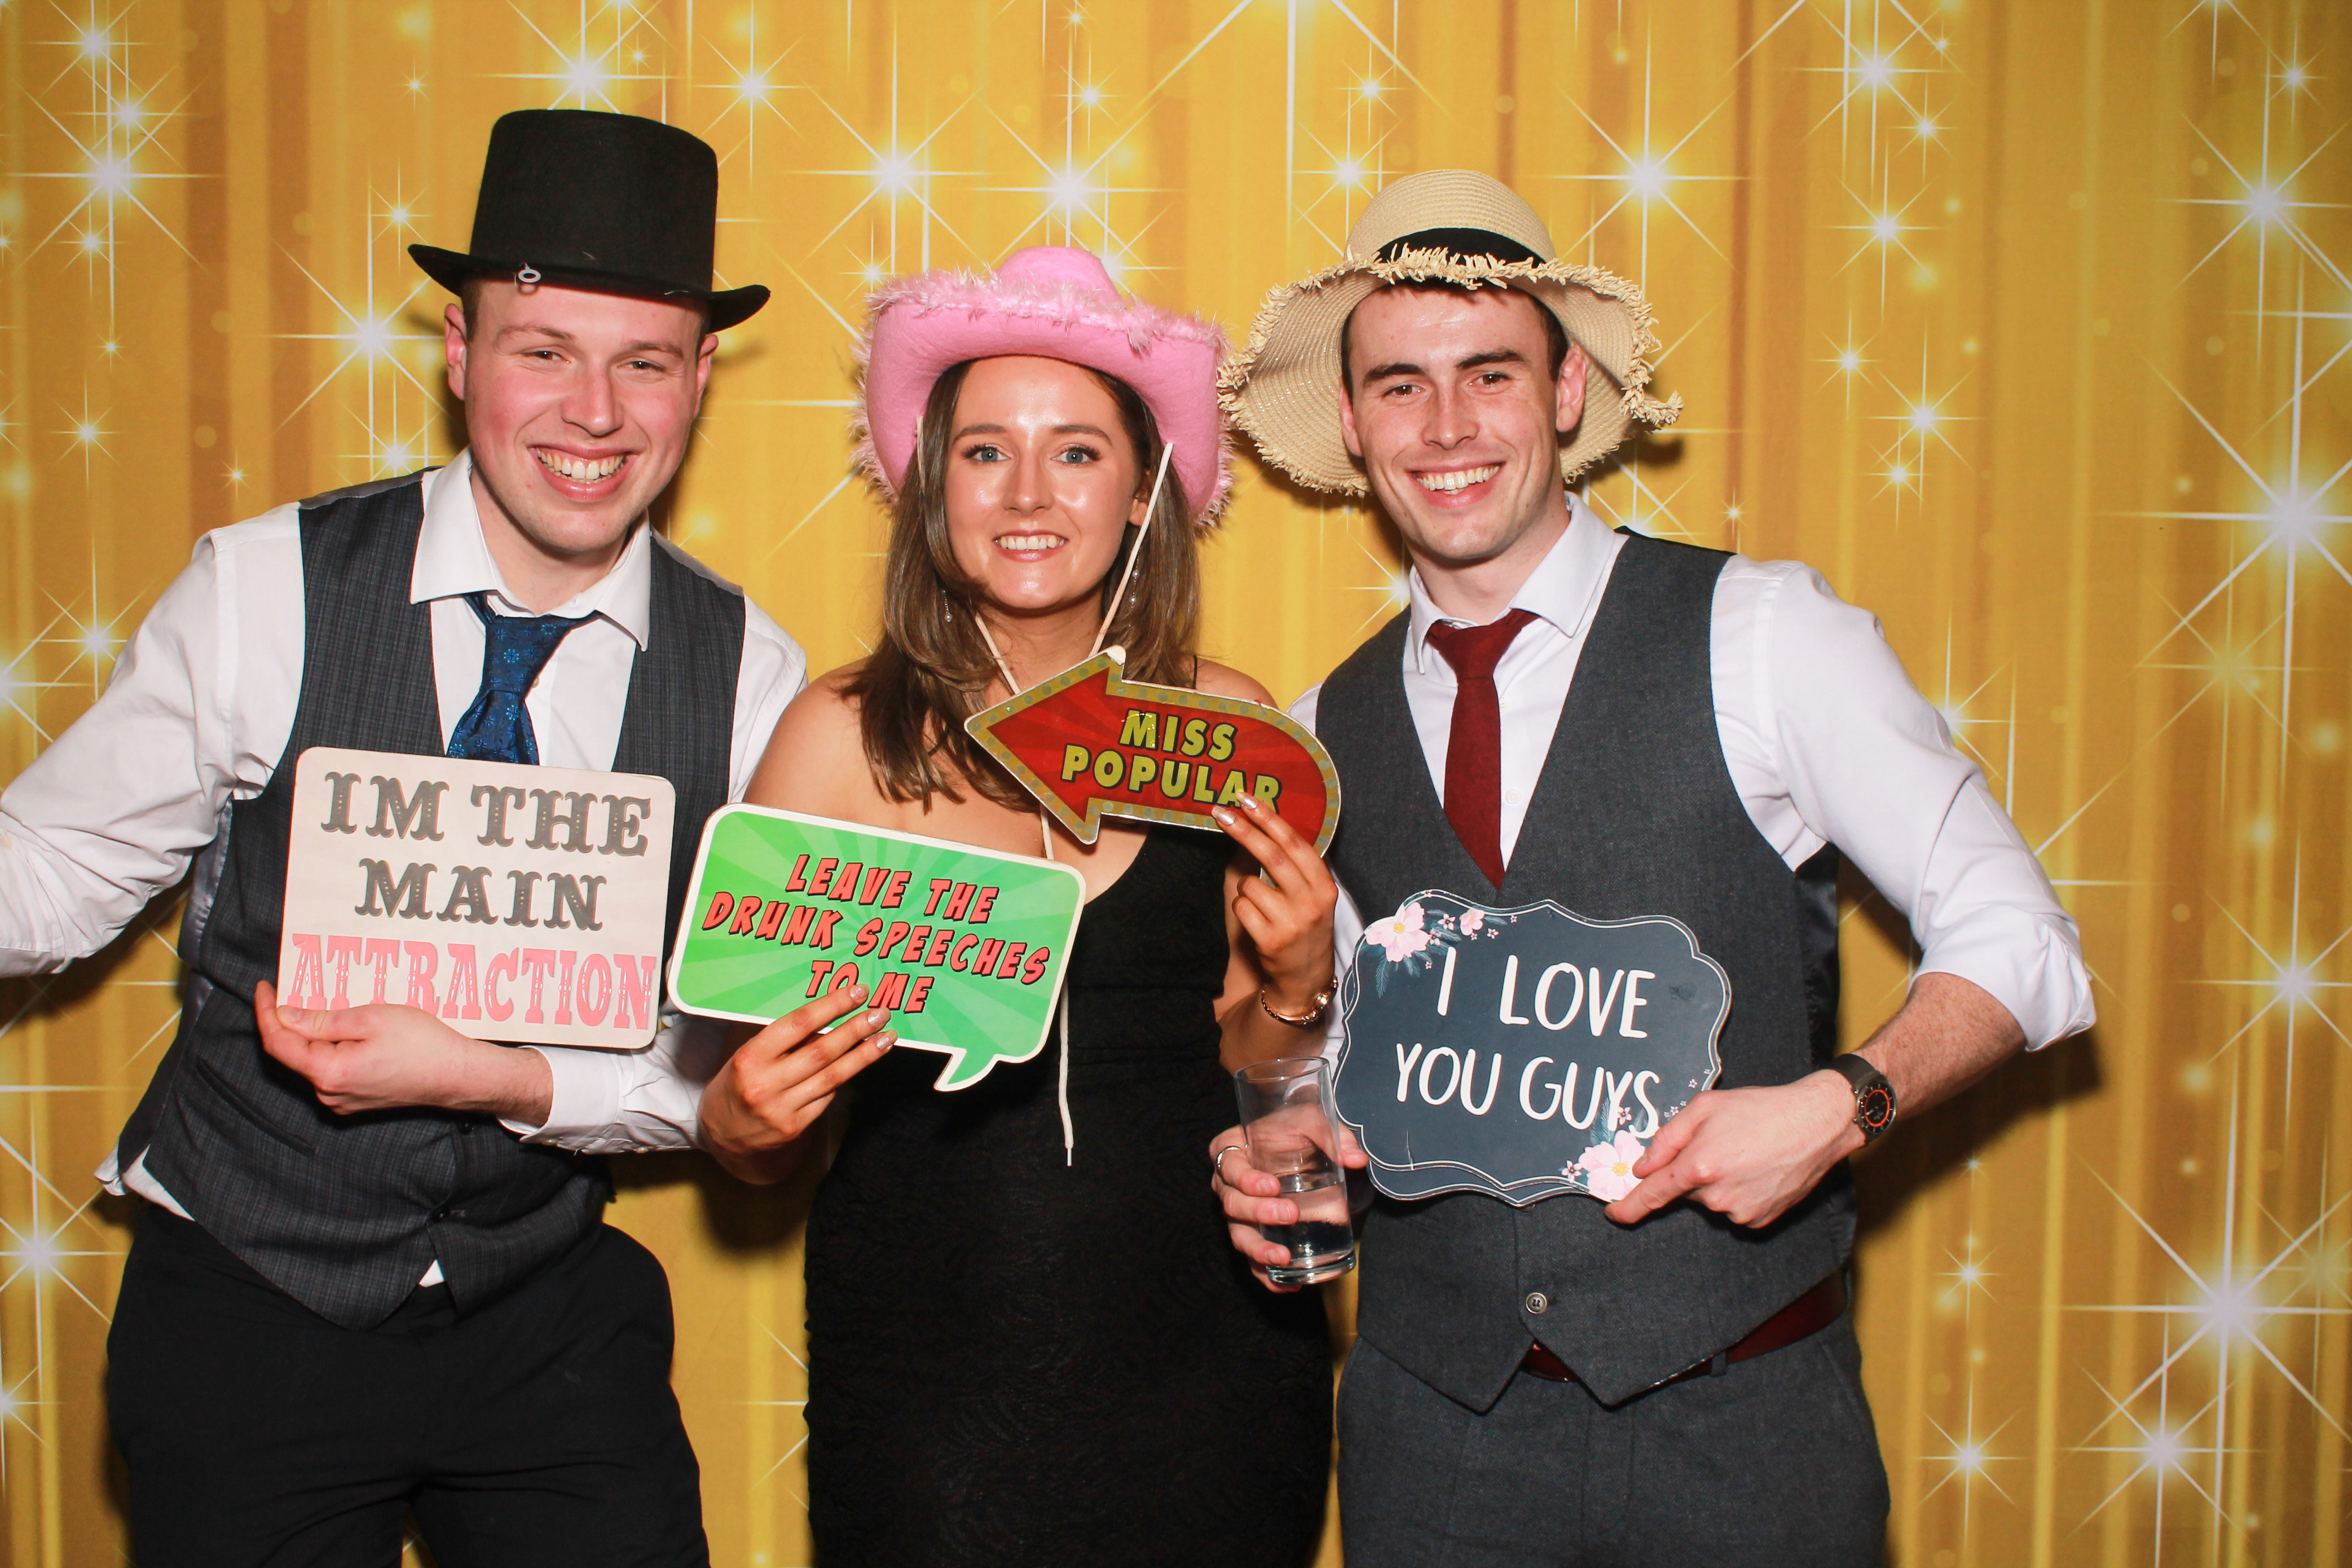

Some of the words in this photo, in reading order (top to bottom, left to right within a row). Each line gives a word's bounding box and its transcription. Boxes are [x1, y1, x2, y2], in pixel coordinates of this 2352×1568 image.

[1119, 709, 1238, 761] MISS
[320, 771, 449, 841] IM
[470, 783, 651, 857] THE
[1060, 744, 1282, 813] POPULAR
[355, 858, 607, 931] MAIN
[785, 854, 911, 908] LEAVE
[924, 879, 999, 924] THE
[702, 891, 842, 949] DRUNK
[853, 917, 1050, 985] SPEECHES
[287, 933, 656, 1030] ATTRACTION
[805, 960, 859, 998] TO
[868, 972, 934, 1013] ME
[1436, 946, 1456, 1016] I
[1499, 955, 1655, 1038] LOVE
[1396, 1043, 1502, 1115] YOU
[1519, 1056, 1660, 1139] GUYS
